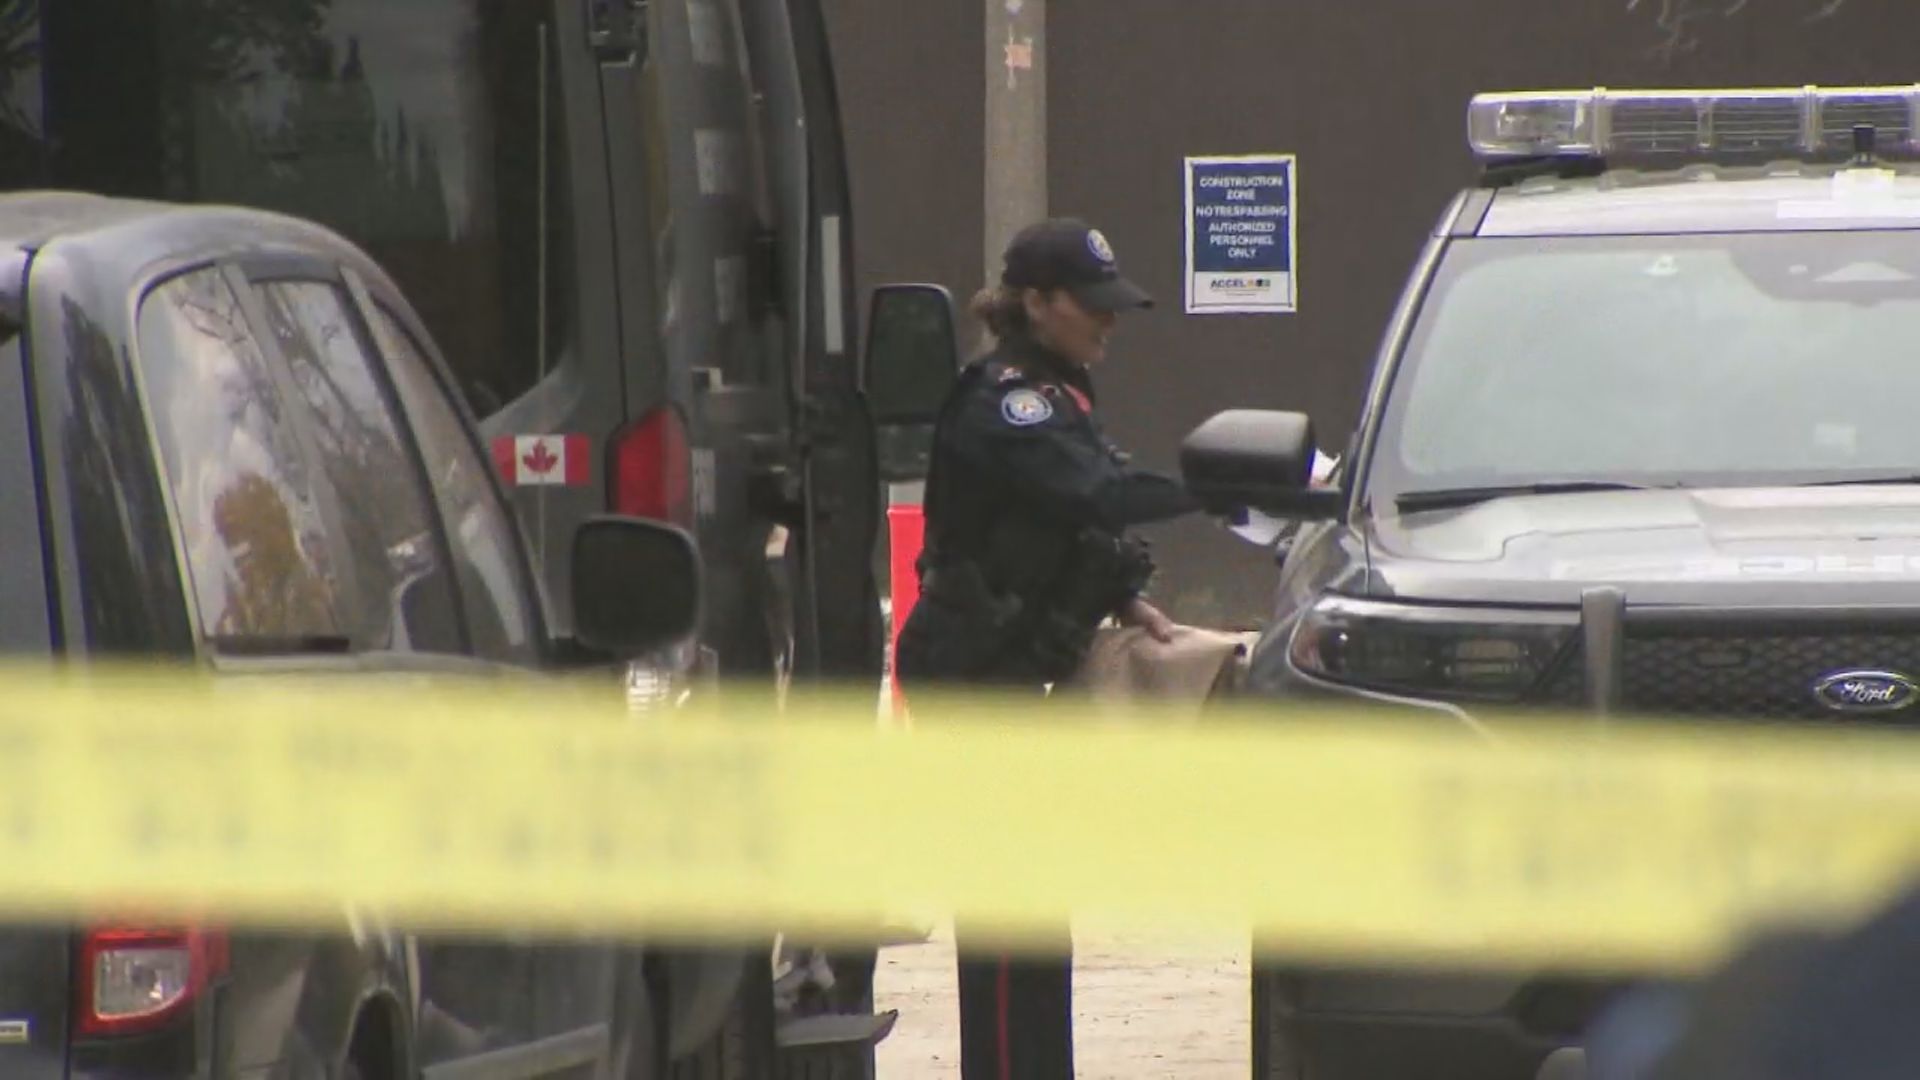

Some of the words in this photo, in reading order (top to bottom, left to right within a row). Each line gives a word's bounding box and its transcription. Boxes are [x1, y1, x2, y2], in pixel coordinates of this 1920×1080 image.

[1199, 176, 1283, 188] CONSTRUCTION
[1226, 189, 1256, 200] ZONE
[1196, 205, 1213, 217] NO
[1213, 205, 1287, 217] TRESPASSING
[1208, 222, 1276, 233] AUTHORIZED
[1209, 234, 1275, 246] PERSONNEL
[1228, 247, 1257, 258] ONLY
[1840, 681, 1896, 703] Ford
